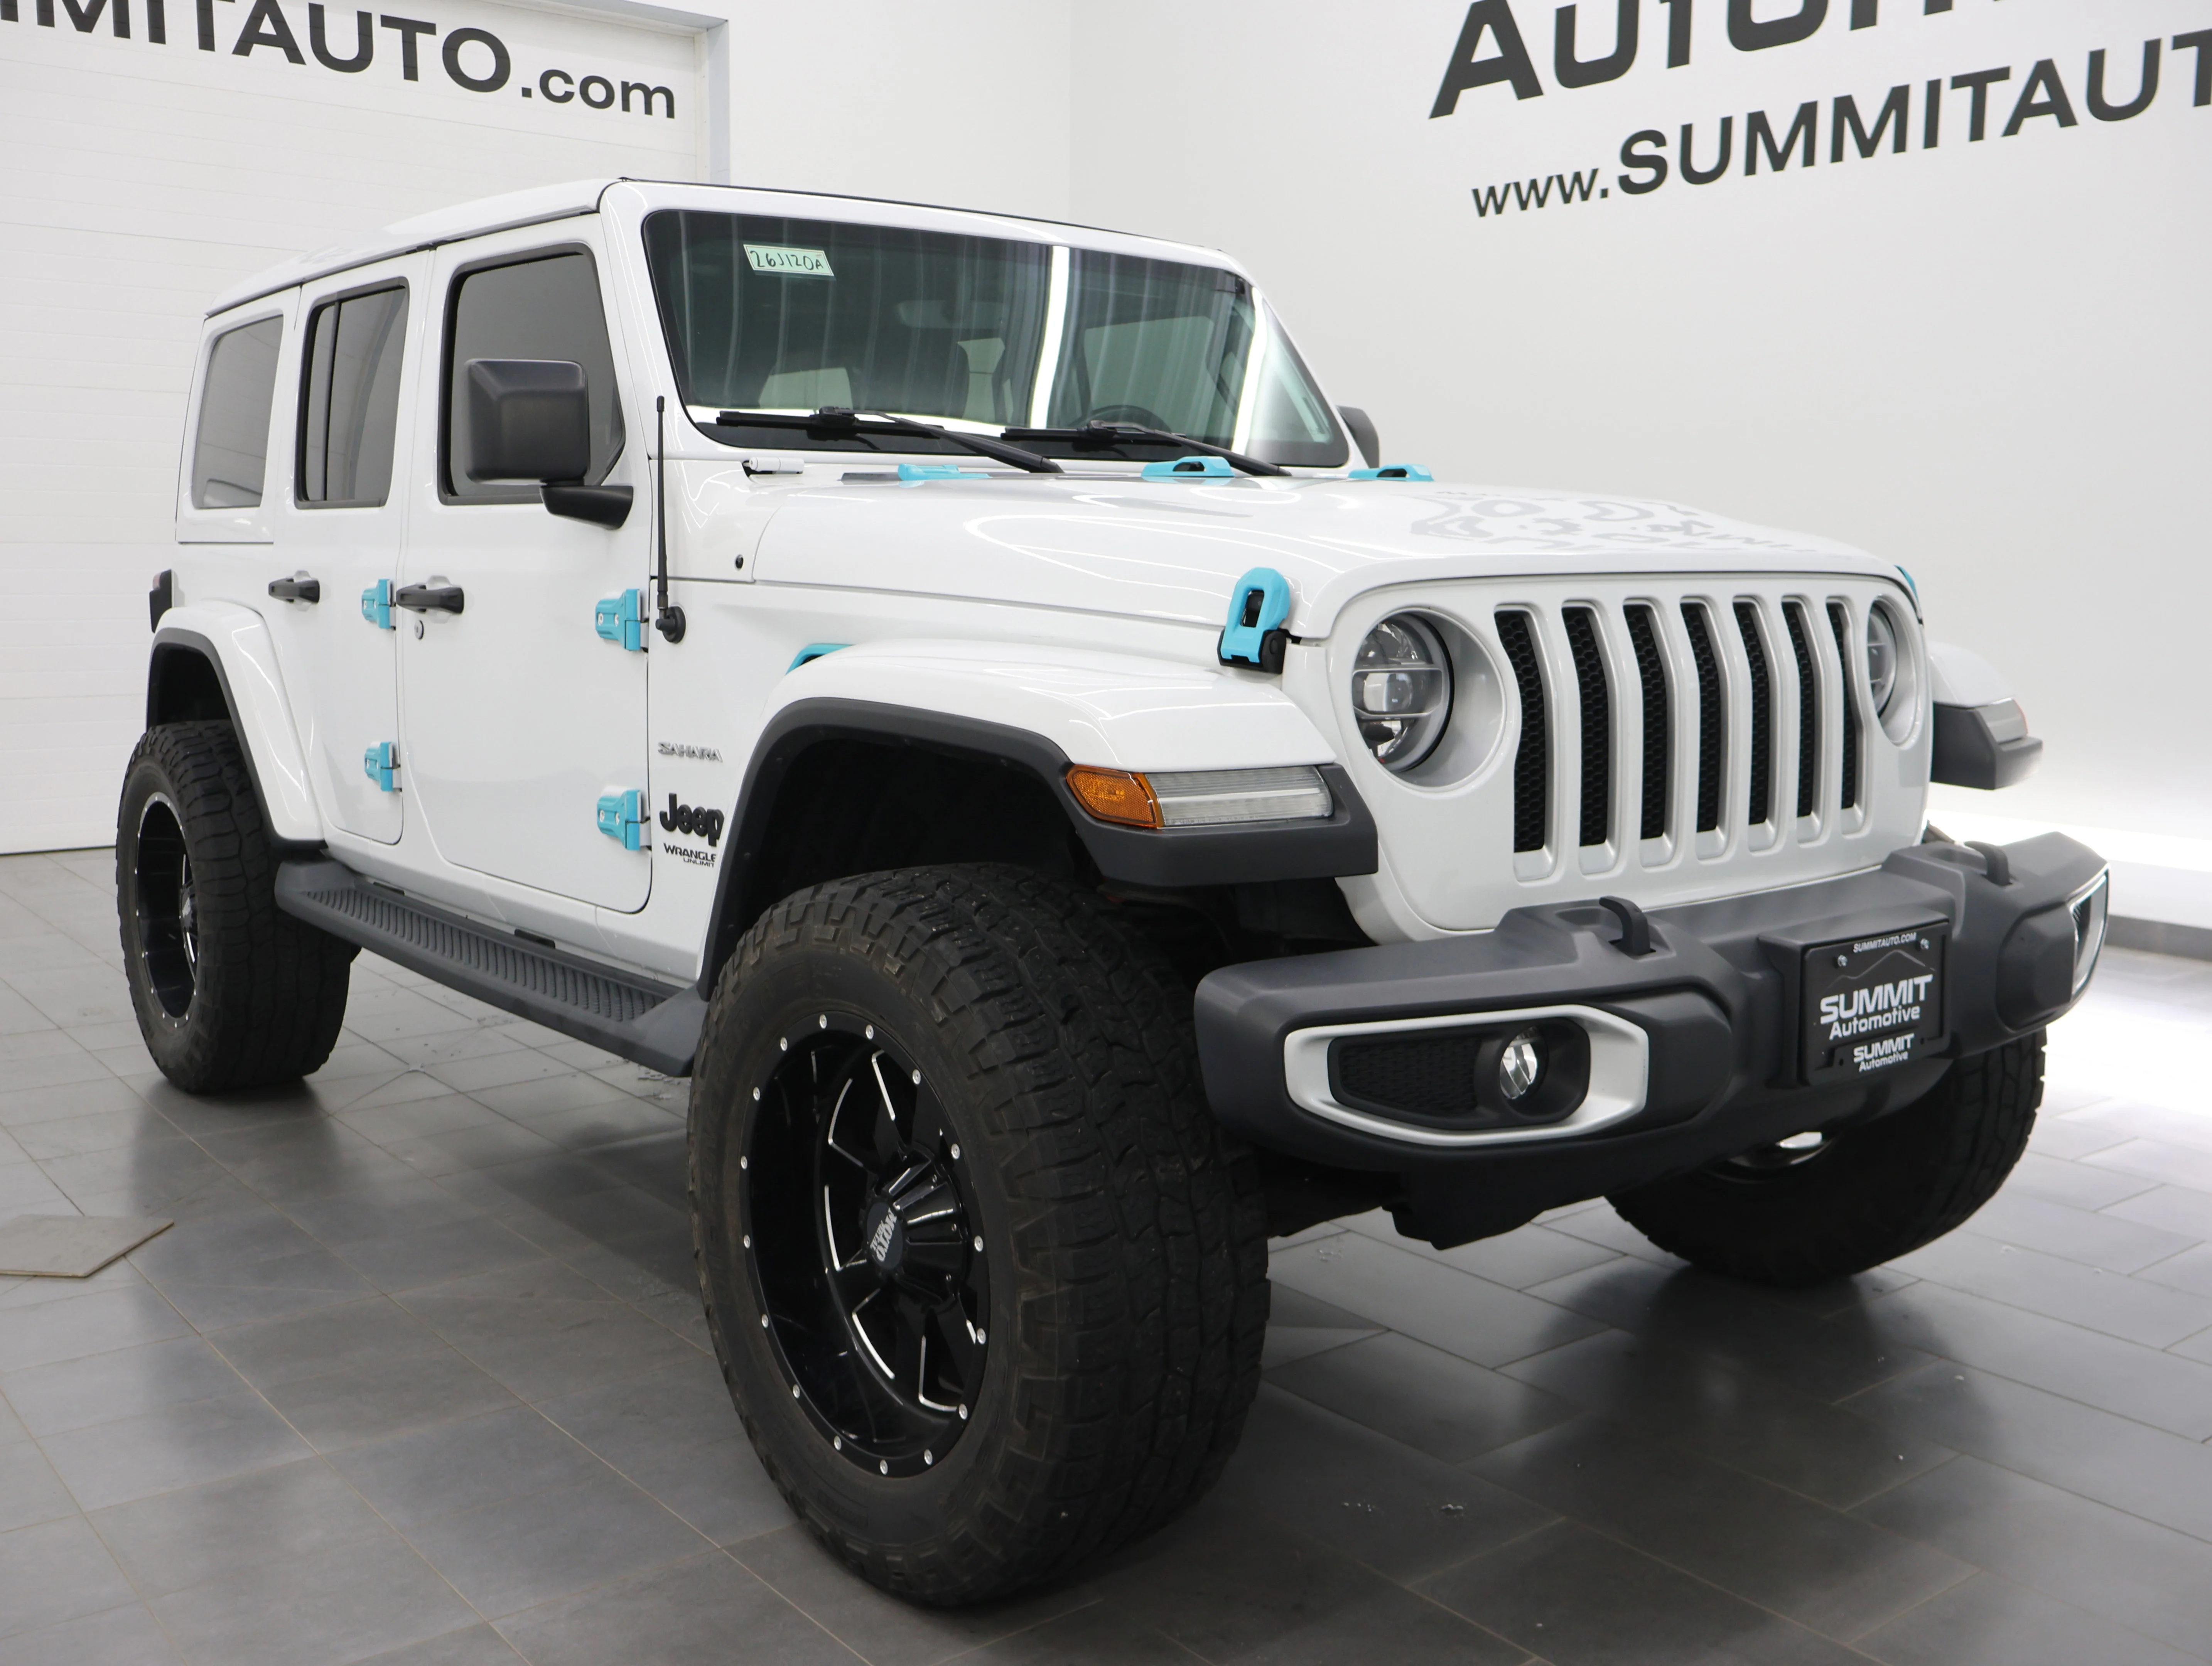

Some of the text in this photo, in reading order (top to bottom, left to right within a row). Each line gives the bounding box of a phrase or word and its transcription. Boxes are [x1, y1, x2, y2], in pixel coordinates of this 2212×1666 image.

[0, 0, 675, 119] MITAUTO.com
[658, 742, 724, 762] SAHARA
[659, 793, 724, 847] Jeep
[1853, 932, 1917, 953] SUMMITAUTO.COM
[1820, 974, 1933, 1024] SUMMIT
[1829, 1005, 1920, 1040] Automotive
[1853, 1033, 1915, 1063] SUMMIT
[1859, 1051, 1909, 1072] Automotive
